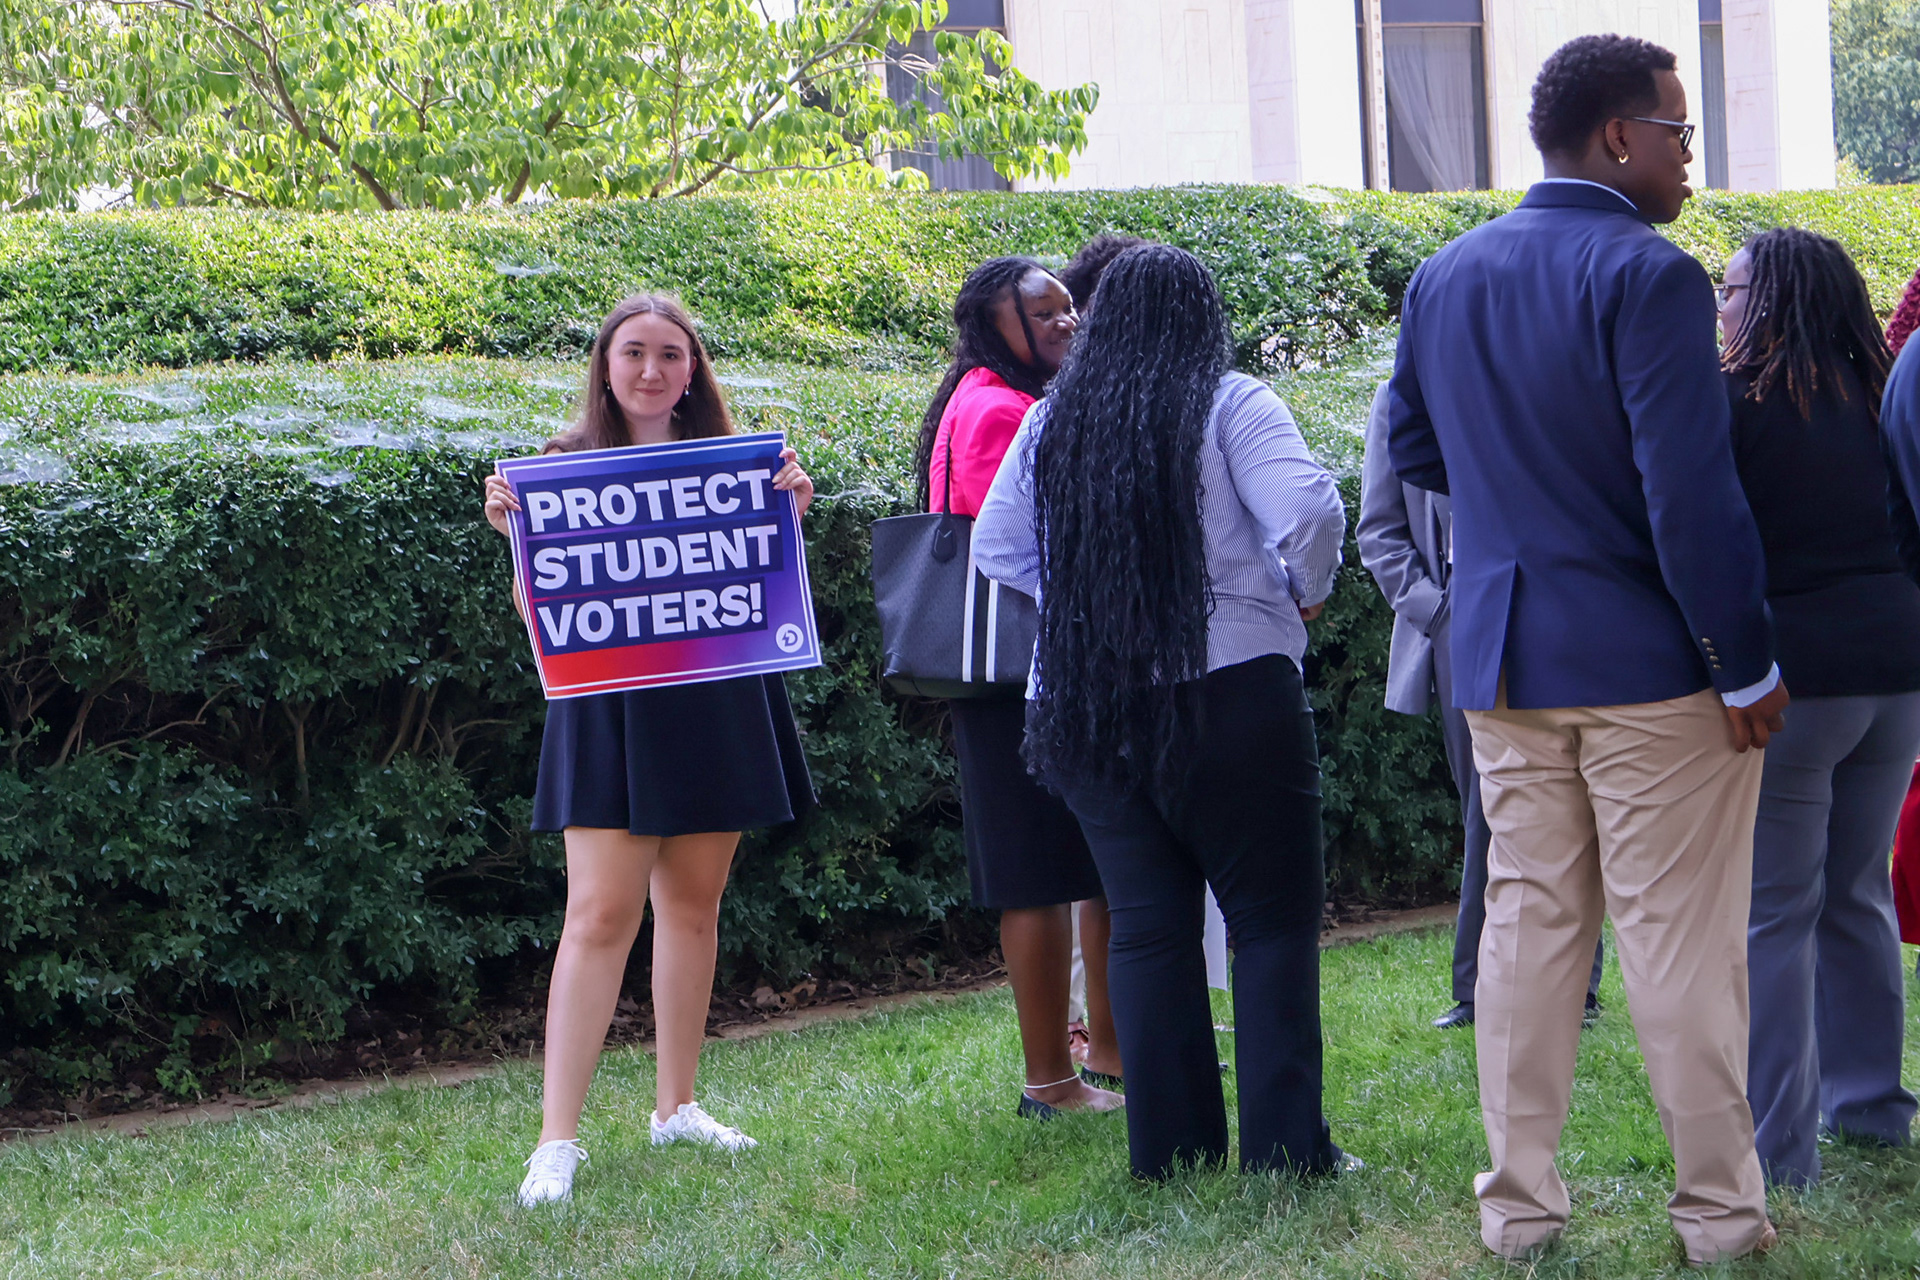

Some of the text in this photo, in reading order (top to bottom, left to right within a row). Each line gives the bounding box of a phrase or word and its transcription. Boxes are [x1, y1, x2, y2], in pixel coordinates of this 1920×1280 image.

[526, 468, 771, 533] PROTECT
[533, 524, 778, 590] STUDENT
[537, 582, 764, 647] VOTERS!
